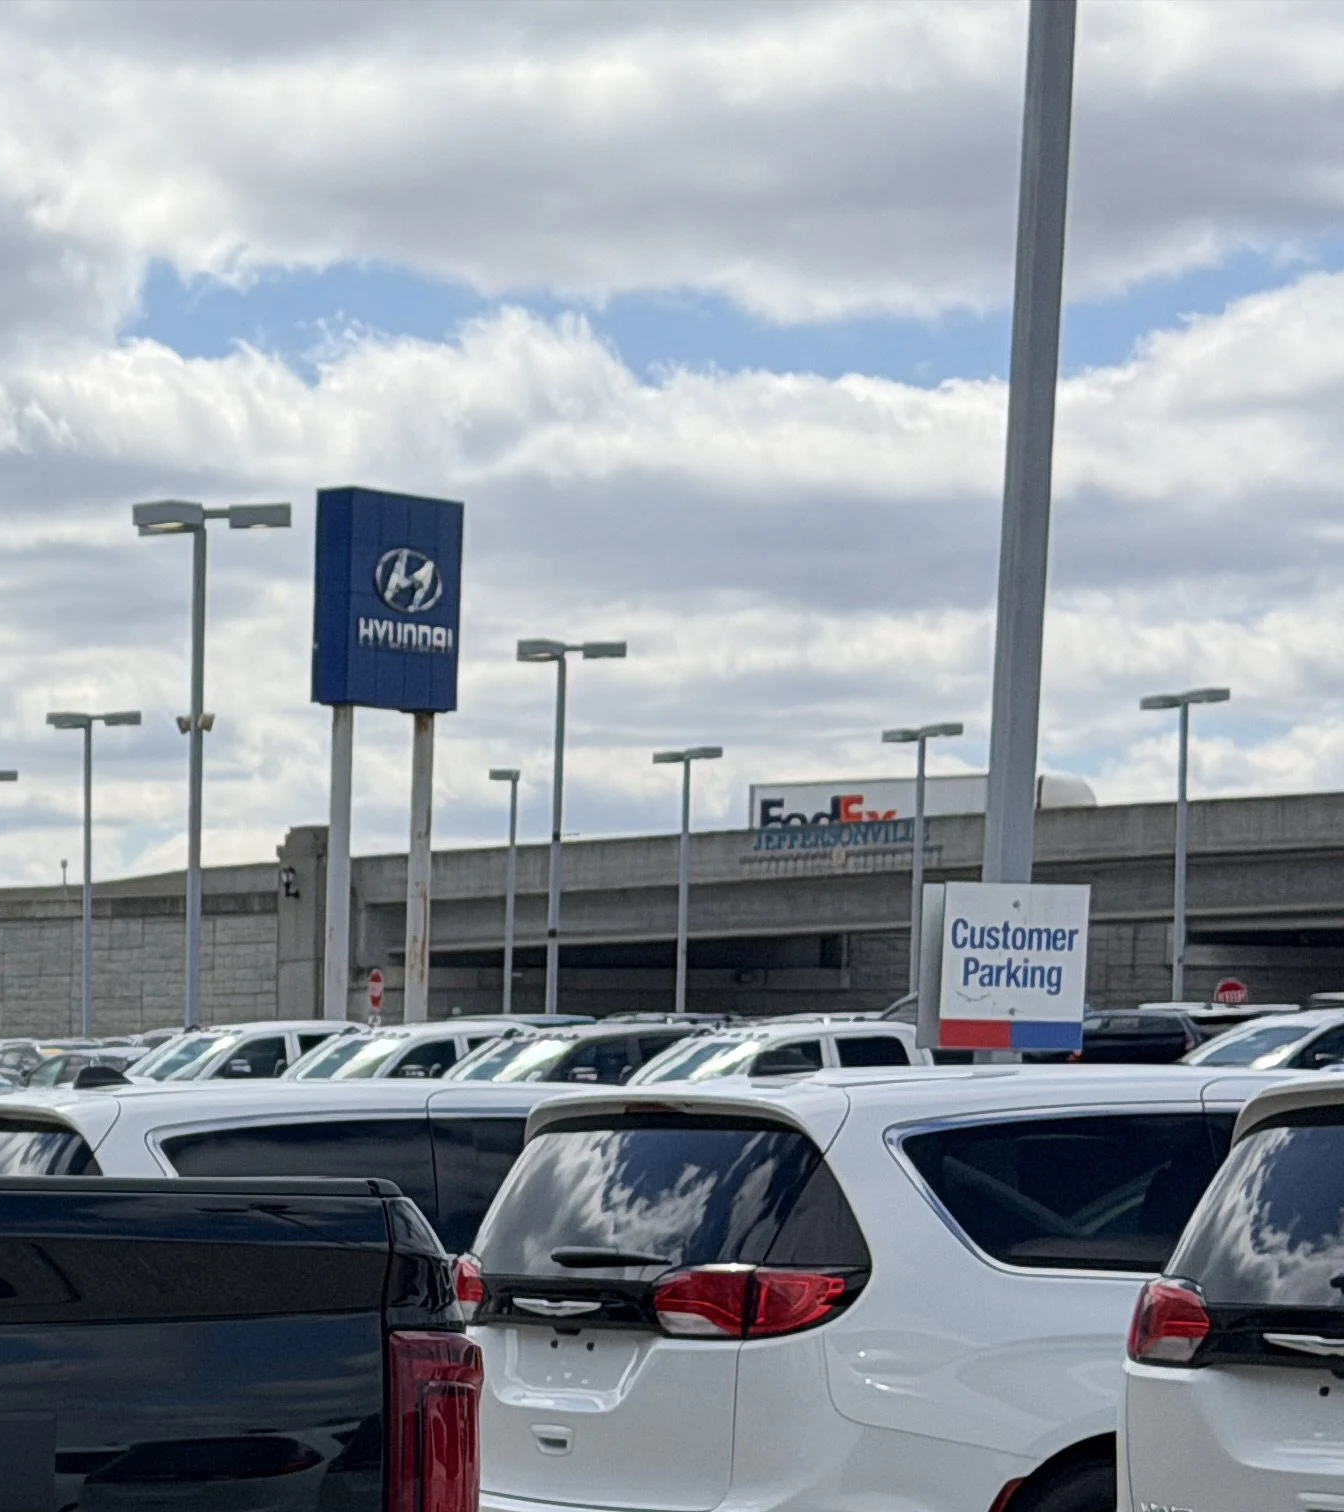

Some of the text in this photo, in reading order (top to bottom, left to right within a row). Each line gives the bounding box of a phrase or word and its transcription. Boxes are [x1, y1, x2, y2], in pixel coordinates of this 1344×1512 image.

[359, 617, 453, 653] HYUNDAI
[951, 918, 1079, 952] Customer
[962, 957, 1063, 996] Parking
